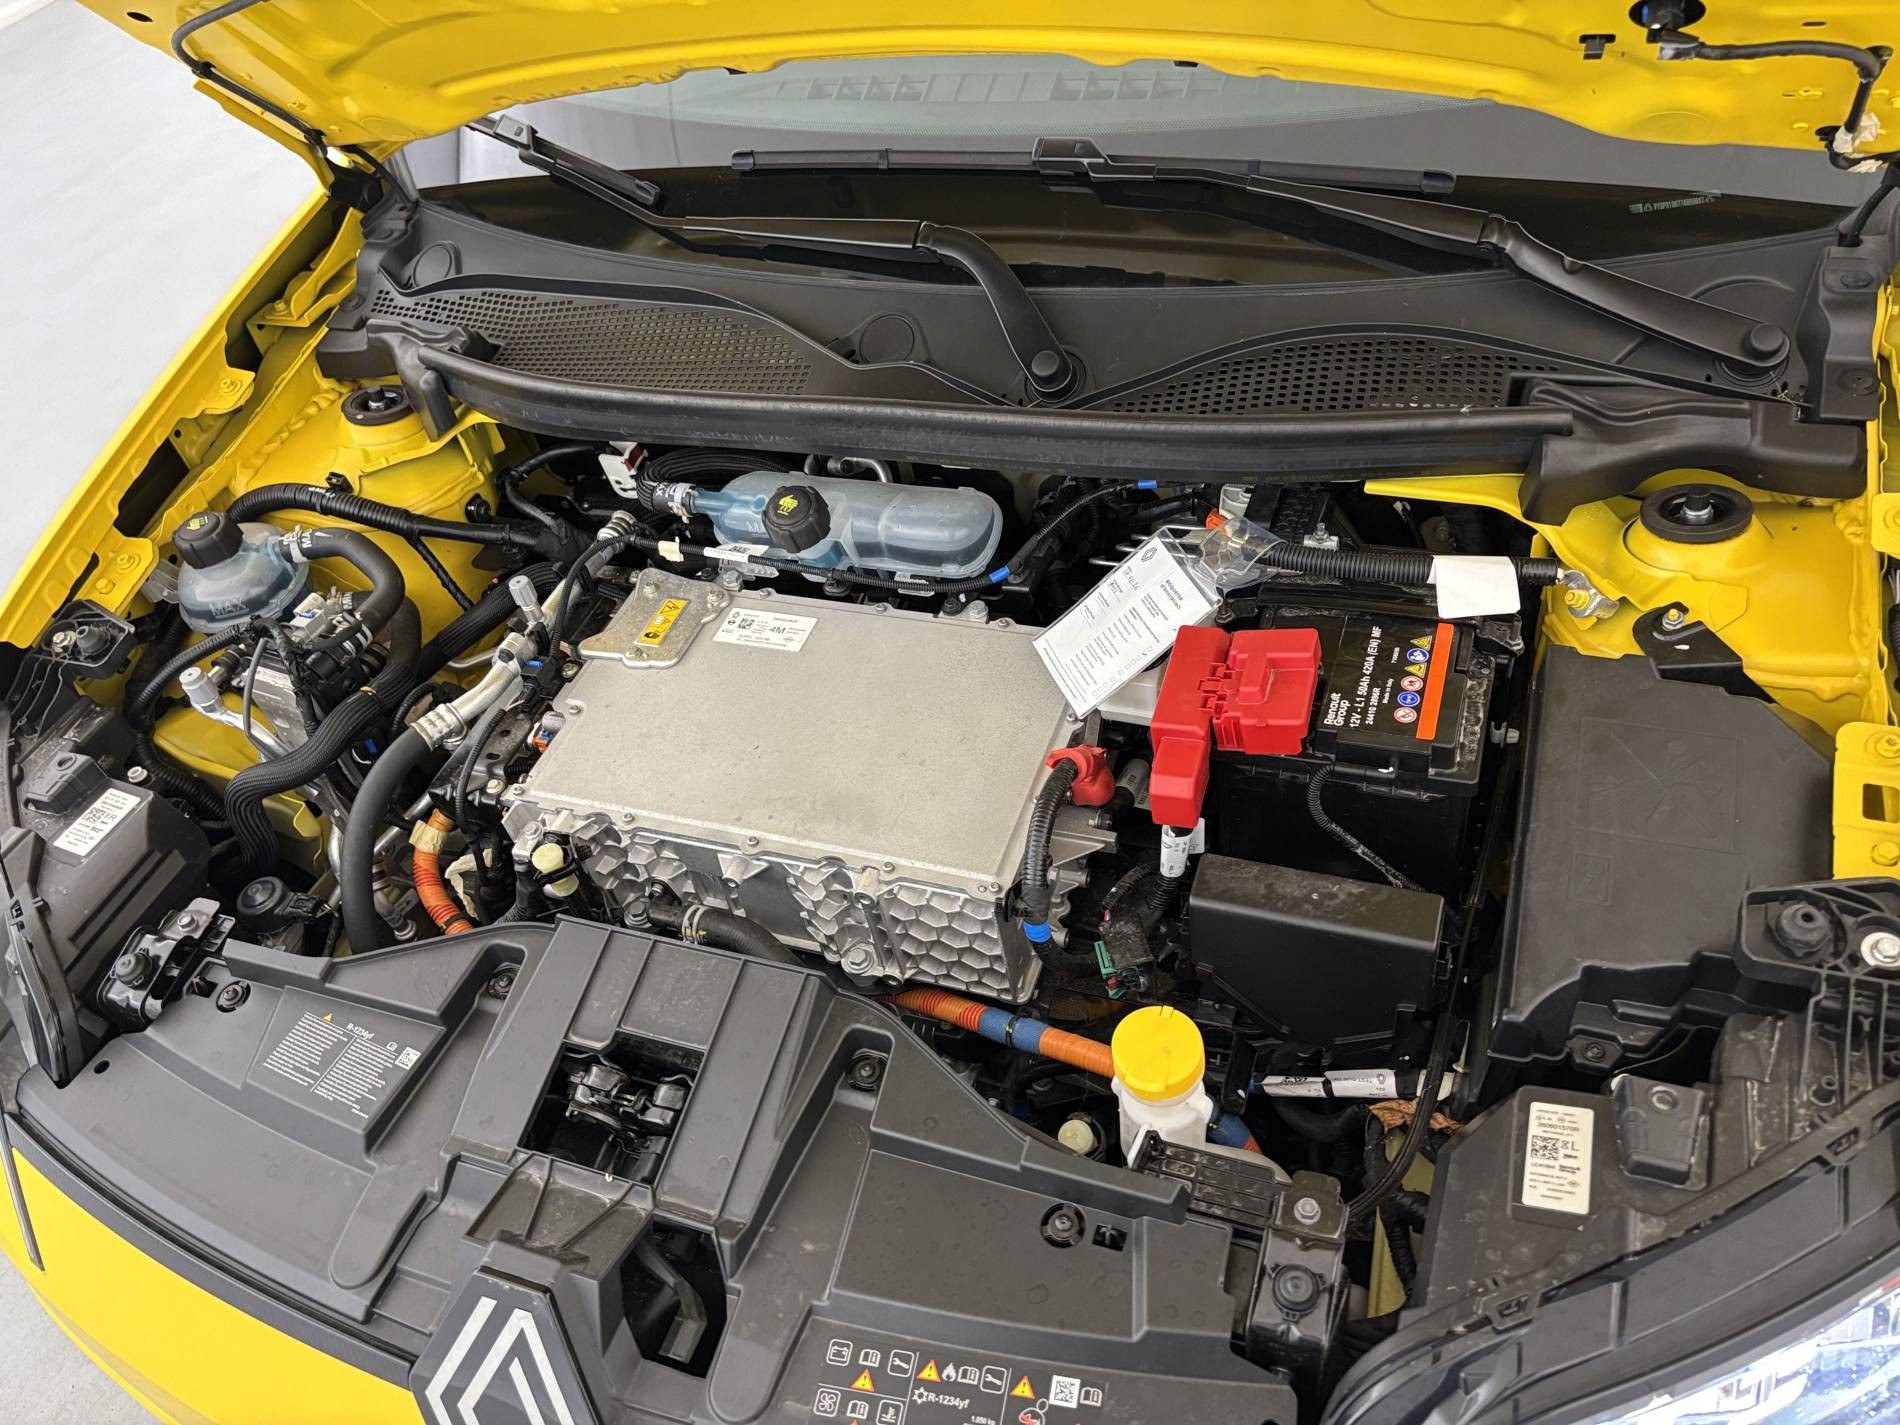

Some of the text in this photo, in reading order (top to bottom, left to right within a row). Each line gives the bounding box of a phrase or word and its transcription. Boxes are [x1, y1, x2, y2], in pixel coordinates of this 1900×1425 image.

[769, 626, 786, 634] 4M
[1371, 625, 1382, 638] MF
[1367, 639, 1382, 655] (EN)
[1362, 655, 1375, 675] 420A
[1357, 675, 1371, 696] 50Ah
[1323, 692, 1341, 725] Renault
[1354, 697, 1365, 707] L1
[1334, 700, 1351, 726] Group
[1349, 712, 1361, 728] 12V
[1365, 706, 1377, 725] 24410
[346, 1022, 374, 1040] R-1234yf
[927, 1392, 970, 1410] R-1234yf
